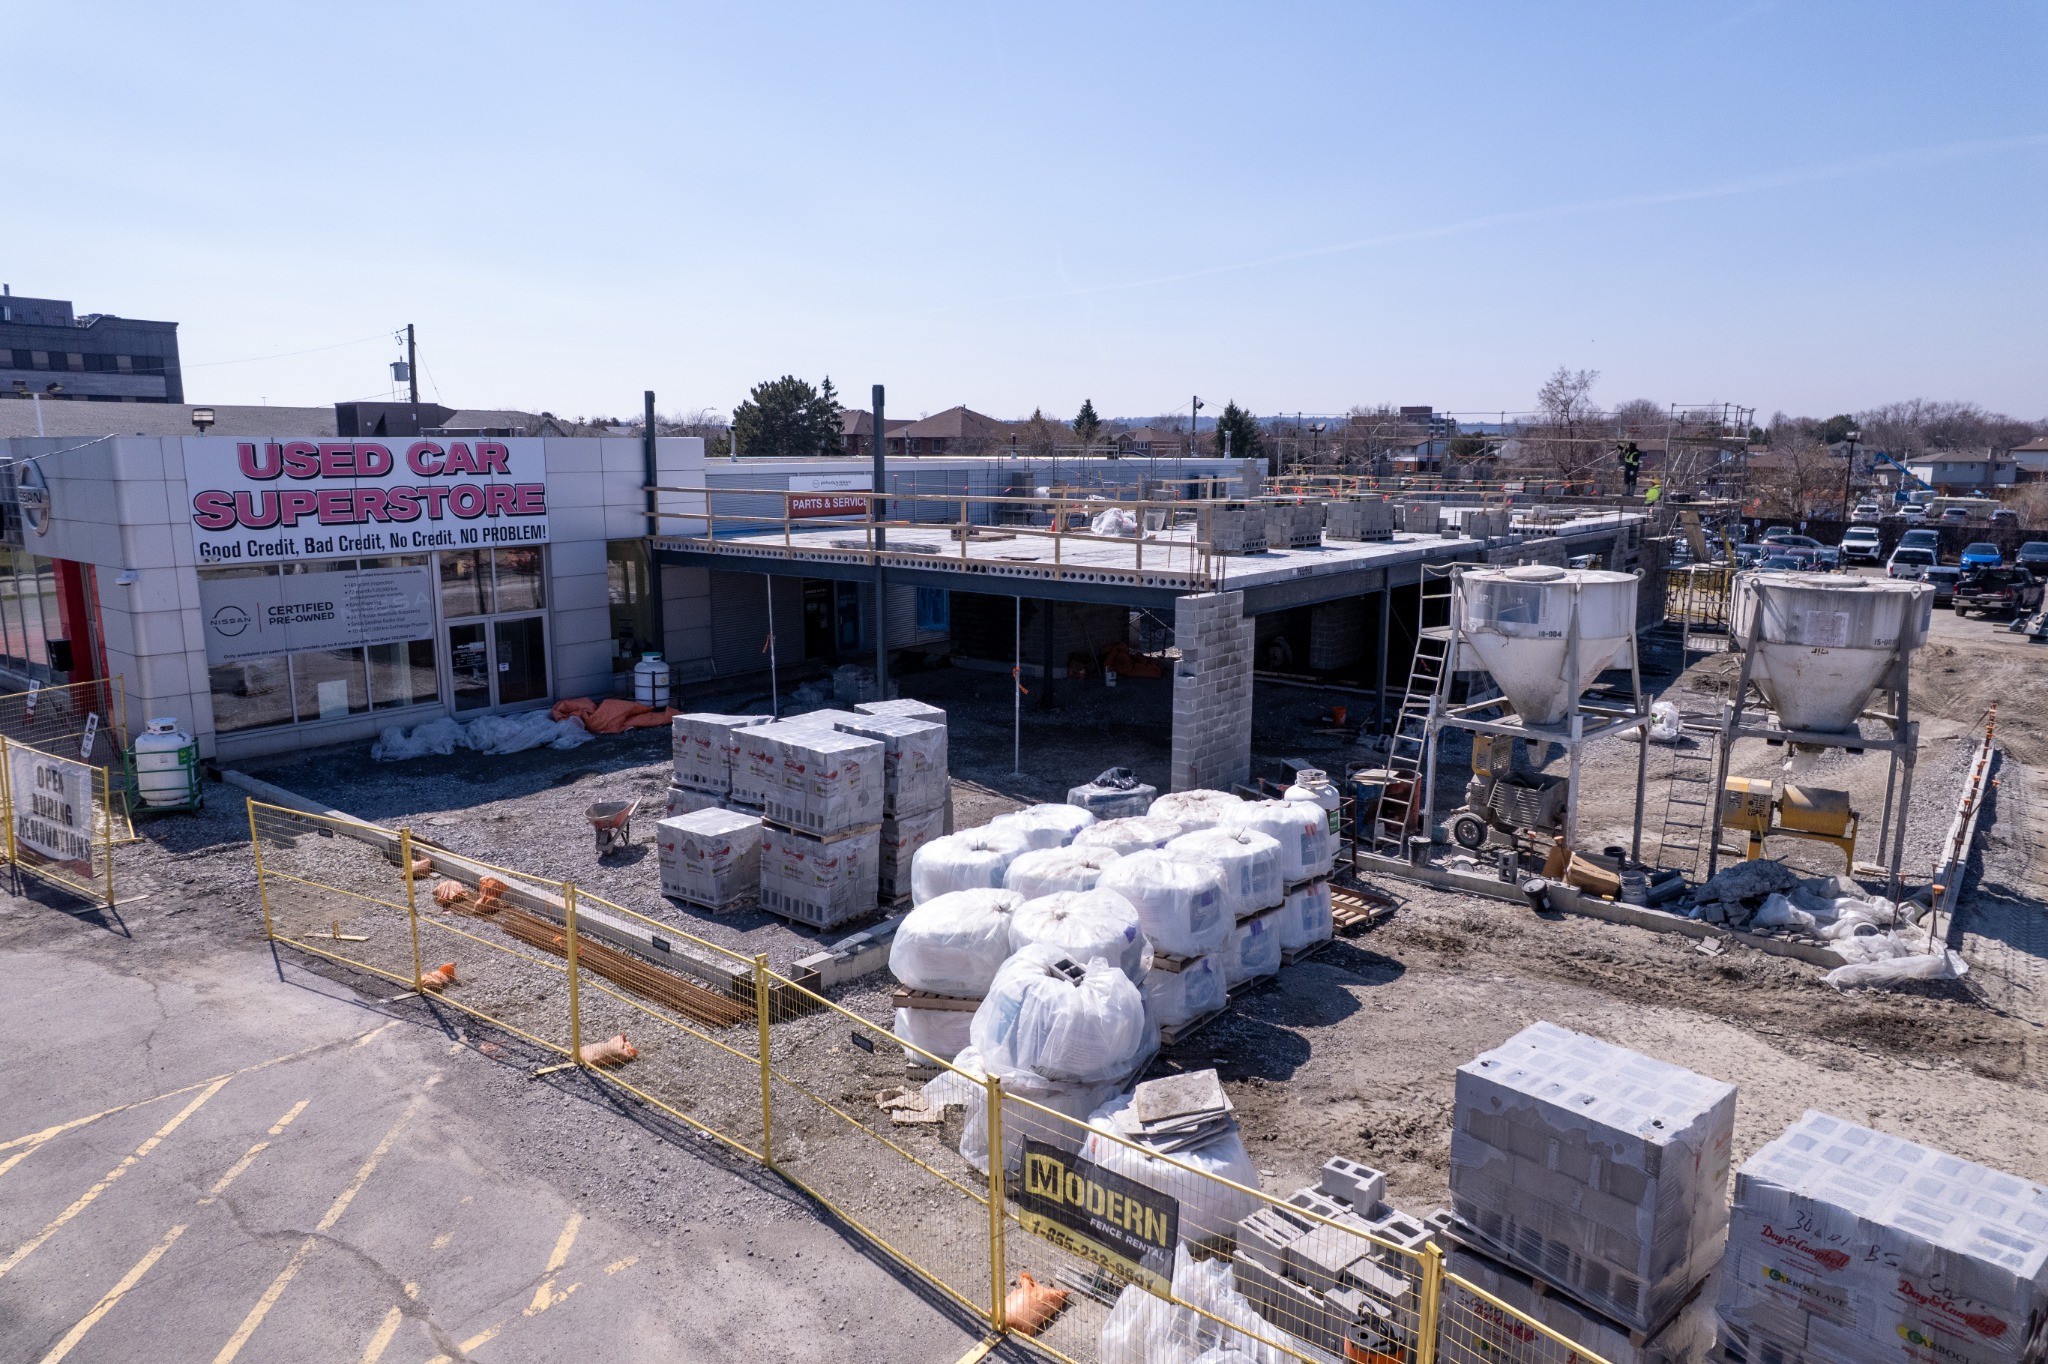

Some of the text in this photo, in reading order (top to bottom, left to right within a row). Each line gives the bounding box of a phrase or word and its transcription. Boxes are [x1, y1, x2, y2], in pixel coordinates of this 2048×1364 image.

[236, 441, 512, 480] USED CAR
[193, 483, 546, 531] SUPERSTORE
[793, 498, 823, 510] PARTS
[824, 498, 831, 509] &
[199, 524, 546, 560] Good Credit, Bad Credit, No Credit, NO PROBLEM!
[210, 601, 334, 626] NISSAN CERTIFIED
[269, 612, 335, 625] PRE-OWNED
[37, 765, 64, 796] OPEN
[32, 792, 73, 827] DURING
[18, 814, 92, 863] RENOVATIONS
[1028, 1156, 1167, 1247] MODERN
[1090, 1217, 1164, 1261] FENCE RENTAL
